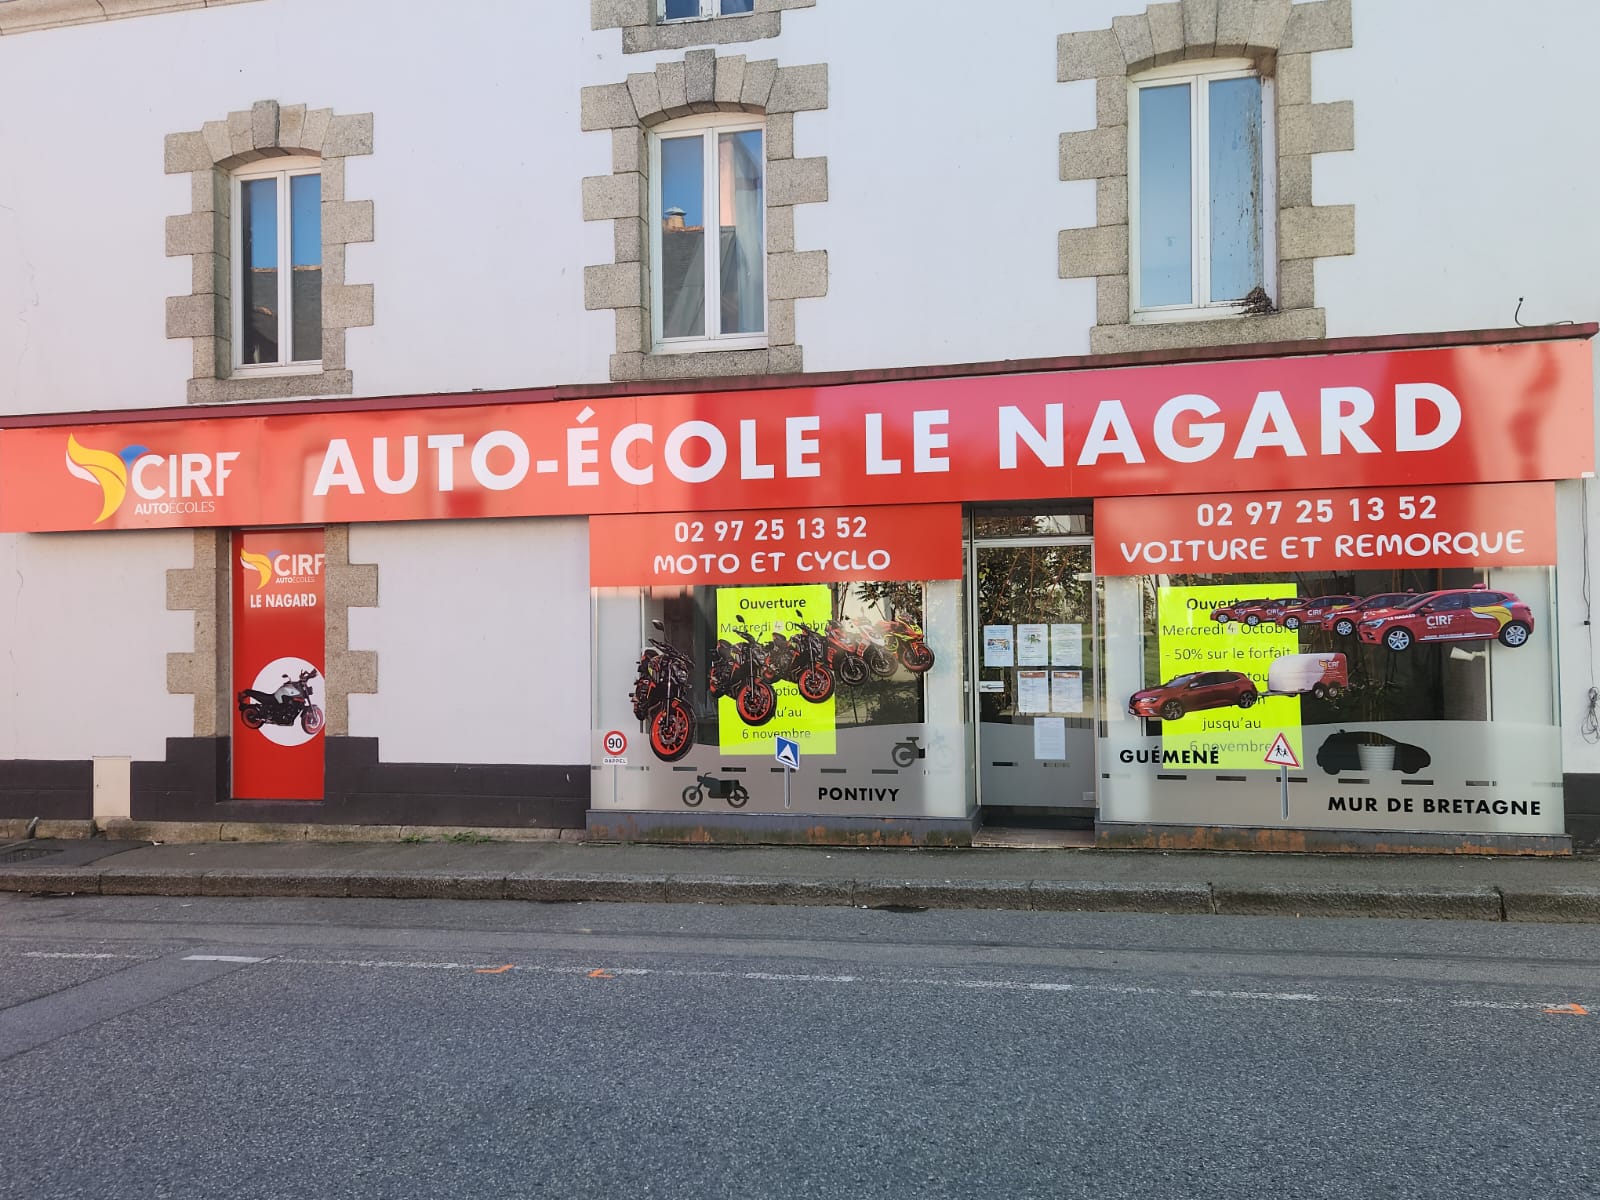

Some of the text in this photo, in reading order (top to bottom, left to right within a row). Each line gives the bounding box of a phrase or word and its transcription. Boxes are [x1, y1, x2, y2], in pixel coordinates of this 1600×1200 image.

[312, 382, 1462, 496] AUTO-ÉCOLE LE NAGARD
[131, 452, 240, 500] CIRF
[1197, 495, 1437, 527] 02 97 25 13 52
[674, 516, 867, 543] 02 97 25 13 52
[1120, 529, 1525, 564] VOITURE ET REMORQUE
[274, 553, 326, 577] CIRF
[653, 549, 891, 575] MOTO ET CYCLO
[250, 593, 317, 609] LE NAGARD
[740, 598, 807, 610] Ouverture
[1426, 614, 1454, 626] CIRF
[1162, 624, 1224, 636] Mercredi
[1174, 648, 1203, 660] 50%
[1207, 650, 1228, 659] sur
[1233, 648, 1245, 659] le
[1249, 647, 1292, 659] forfait
[742, 728, 811, 739] 6 novembre
[608, 738, 622, 748] 90
[1190, 741, 1197, 752] 6
[1119, 745, 1219, 765] GUÉMENÉ
[818, 787, 900, 802] PONTIVY
[1328, 797, 1541, 816] MUR DE BRETAGNE
